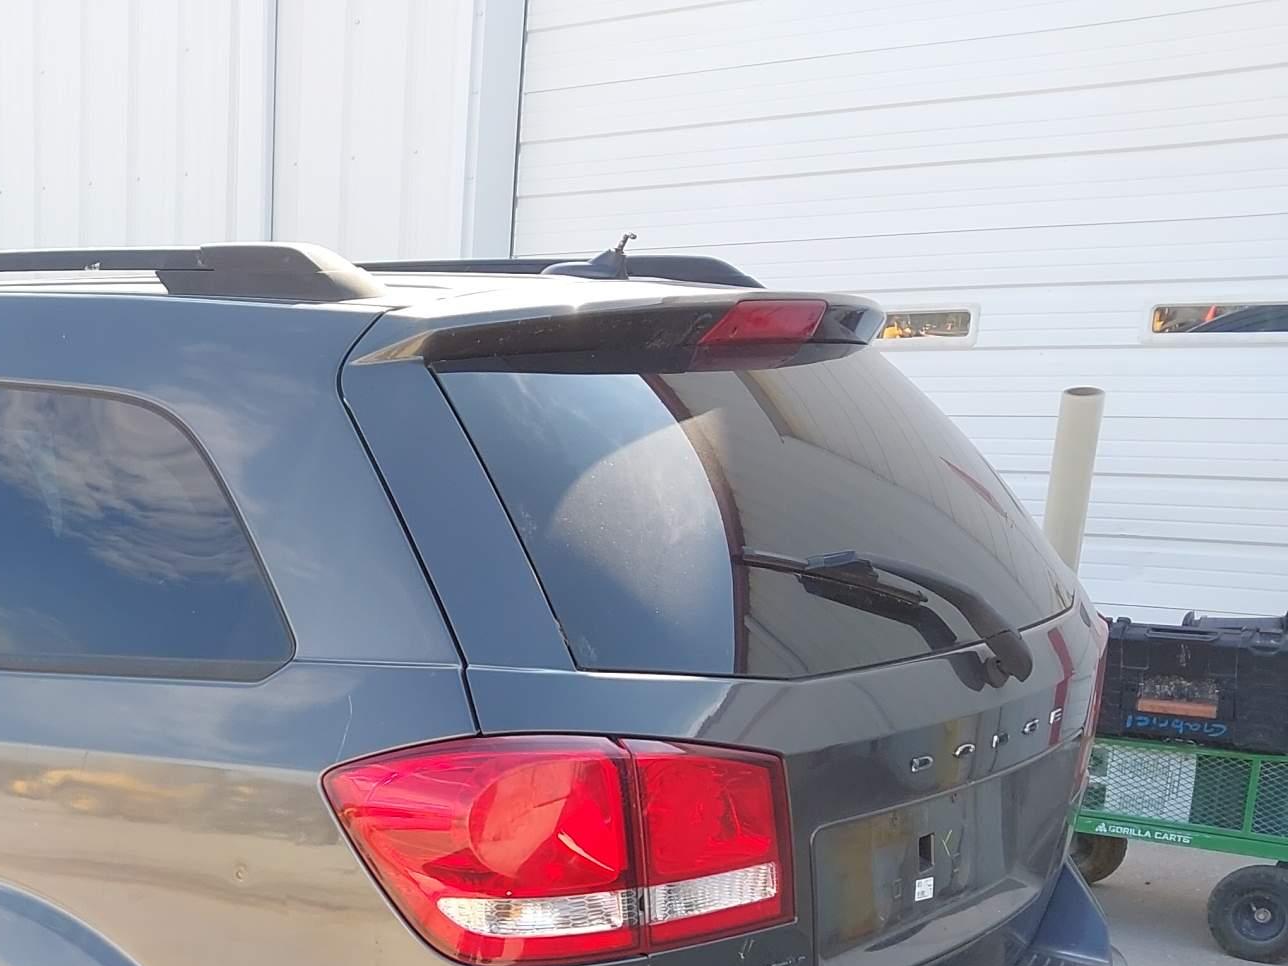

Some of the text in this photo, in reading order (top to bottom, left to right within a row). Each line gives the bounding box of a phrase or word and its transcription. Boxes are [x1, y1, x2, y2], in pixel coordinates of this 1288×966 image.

[911, 707, 1063, 772] DODGE
[1109, 824, 1193, 845] GORILLA CARTS
